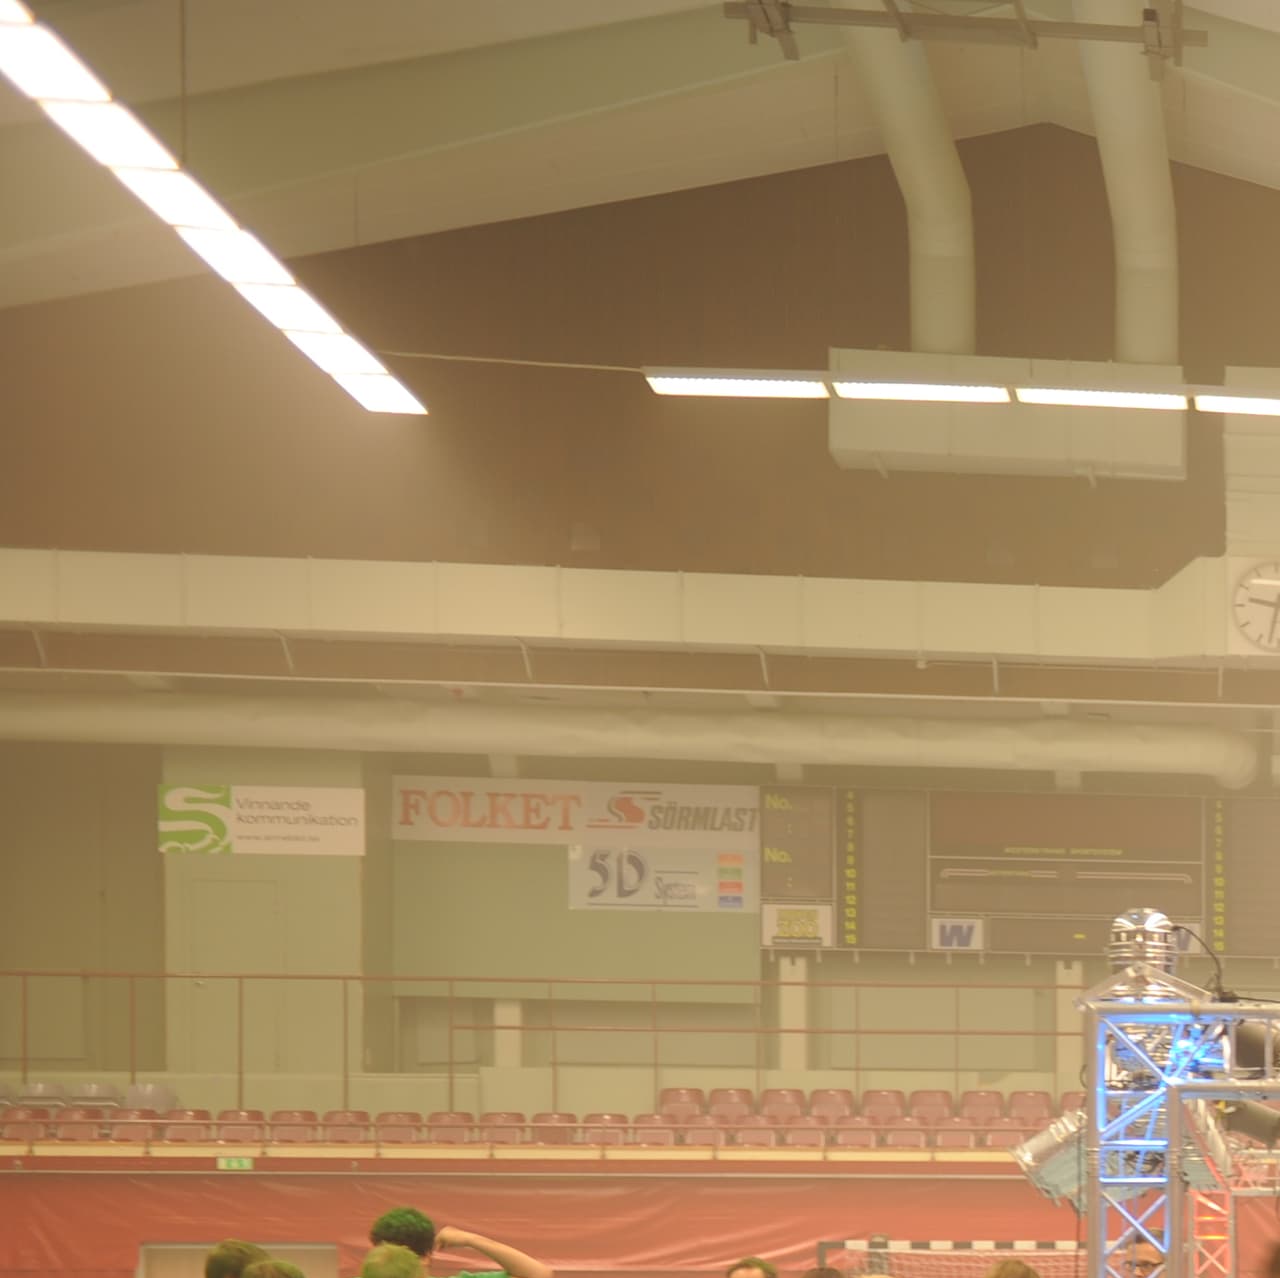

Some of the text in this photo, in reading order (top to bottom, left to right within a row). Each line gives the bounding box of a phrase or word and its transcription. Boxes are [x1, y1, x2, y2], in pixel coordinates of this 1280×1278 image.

[236, 798, 312, 811] Vinnande
[399, 789, 582, 830] FOLKET
[236, 814, 359, 827] kommunikation
[647, 802, 758, 832] SÖRMLAST
